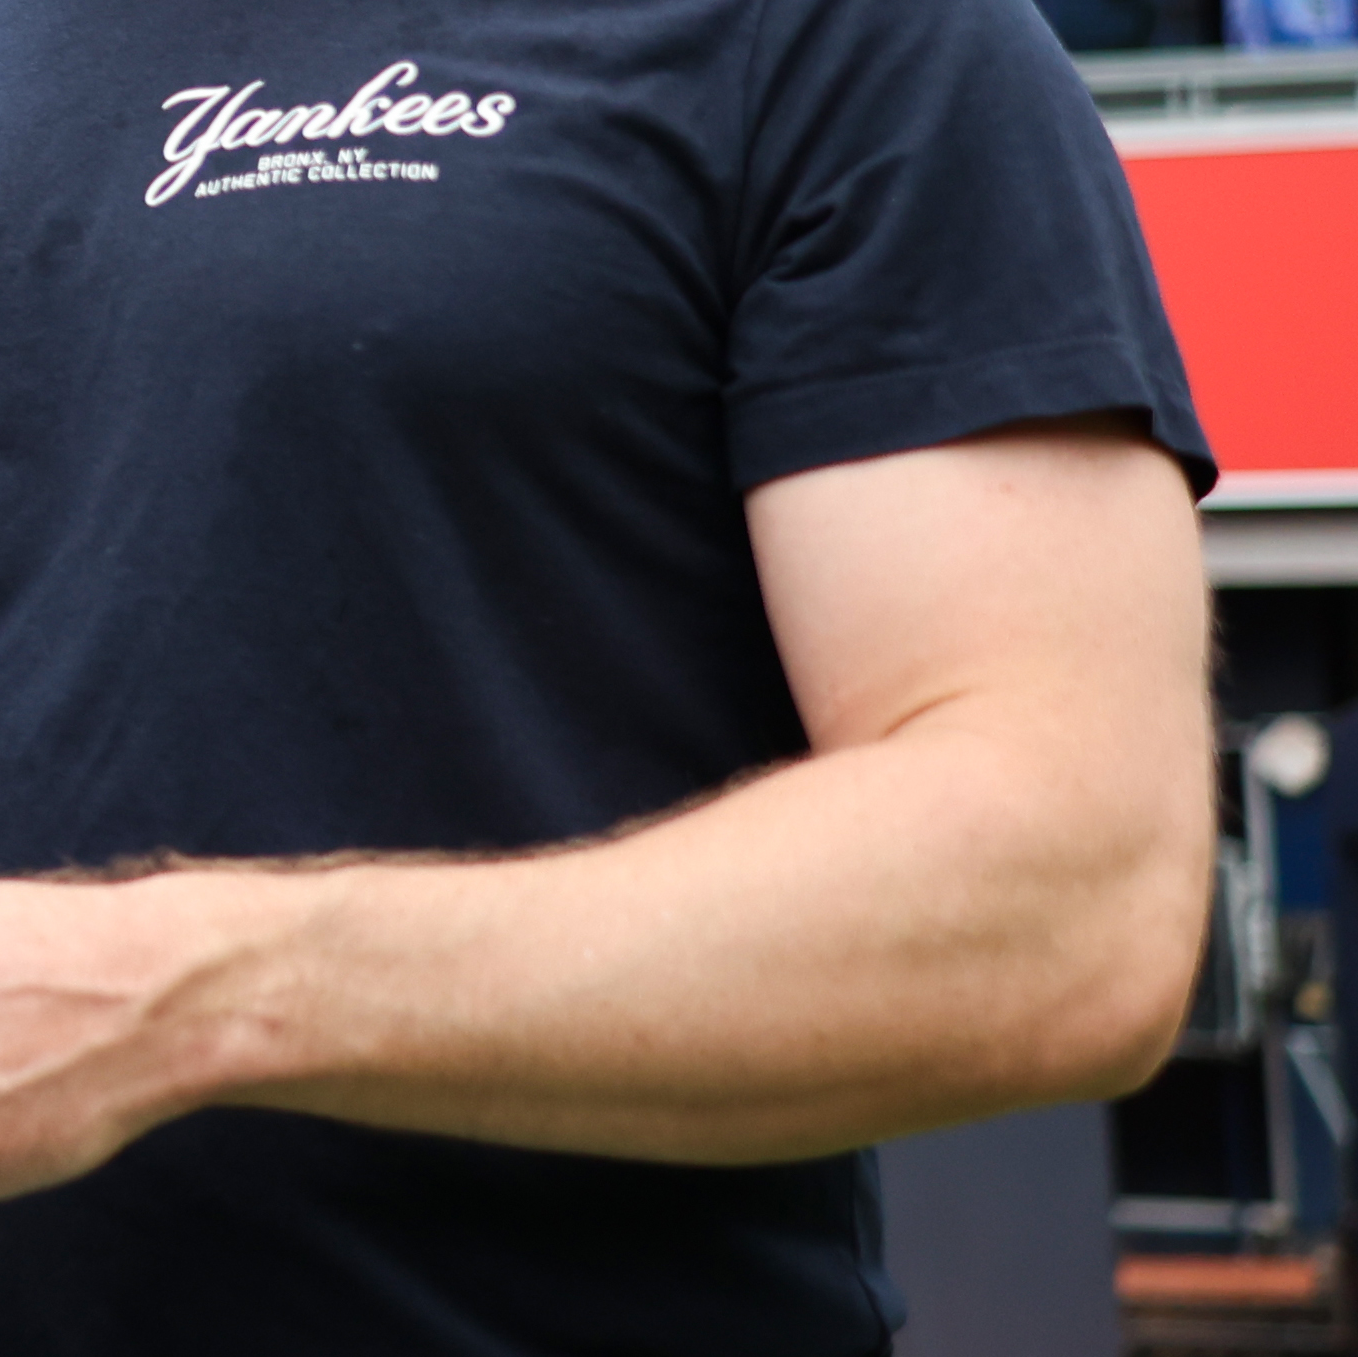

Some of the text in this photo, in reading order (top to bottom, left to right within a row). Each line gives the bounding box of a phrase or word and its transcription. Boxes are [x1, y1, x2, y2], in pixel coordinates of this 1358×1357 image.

[144, 59, 517, 207] Yankees
[337, 147, 369, 165] NY
[194, 160, 440, 198] AUTHENTIC COLLECTION
